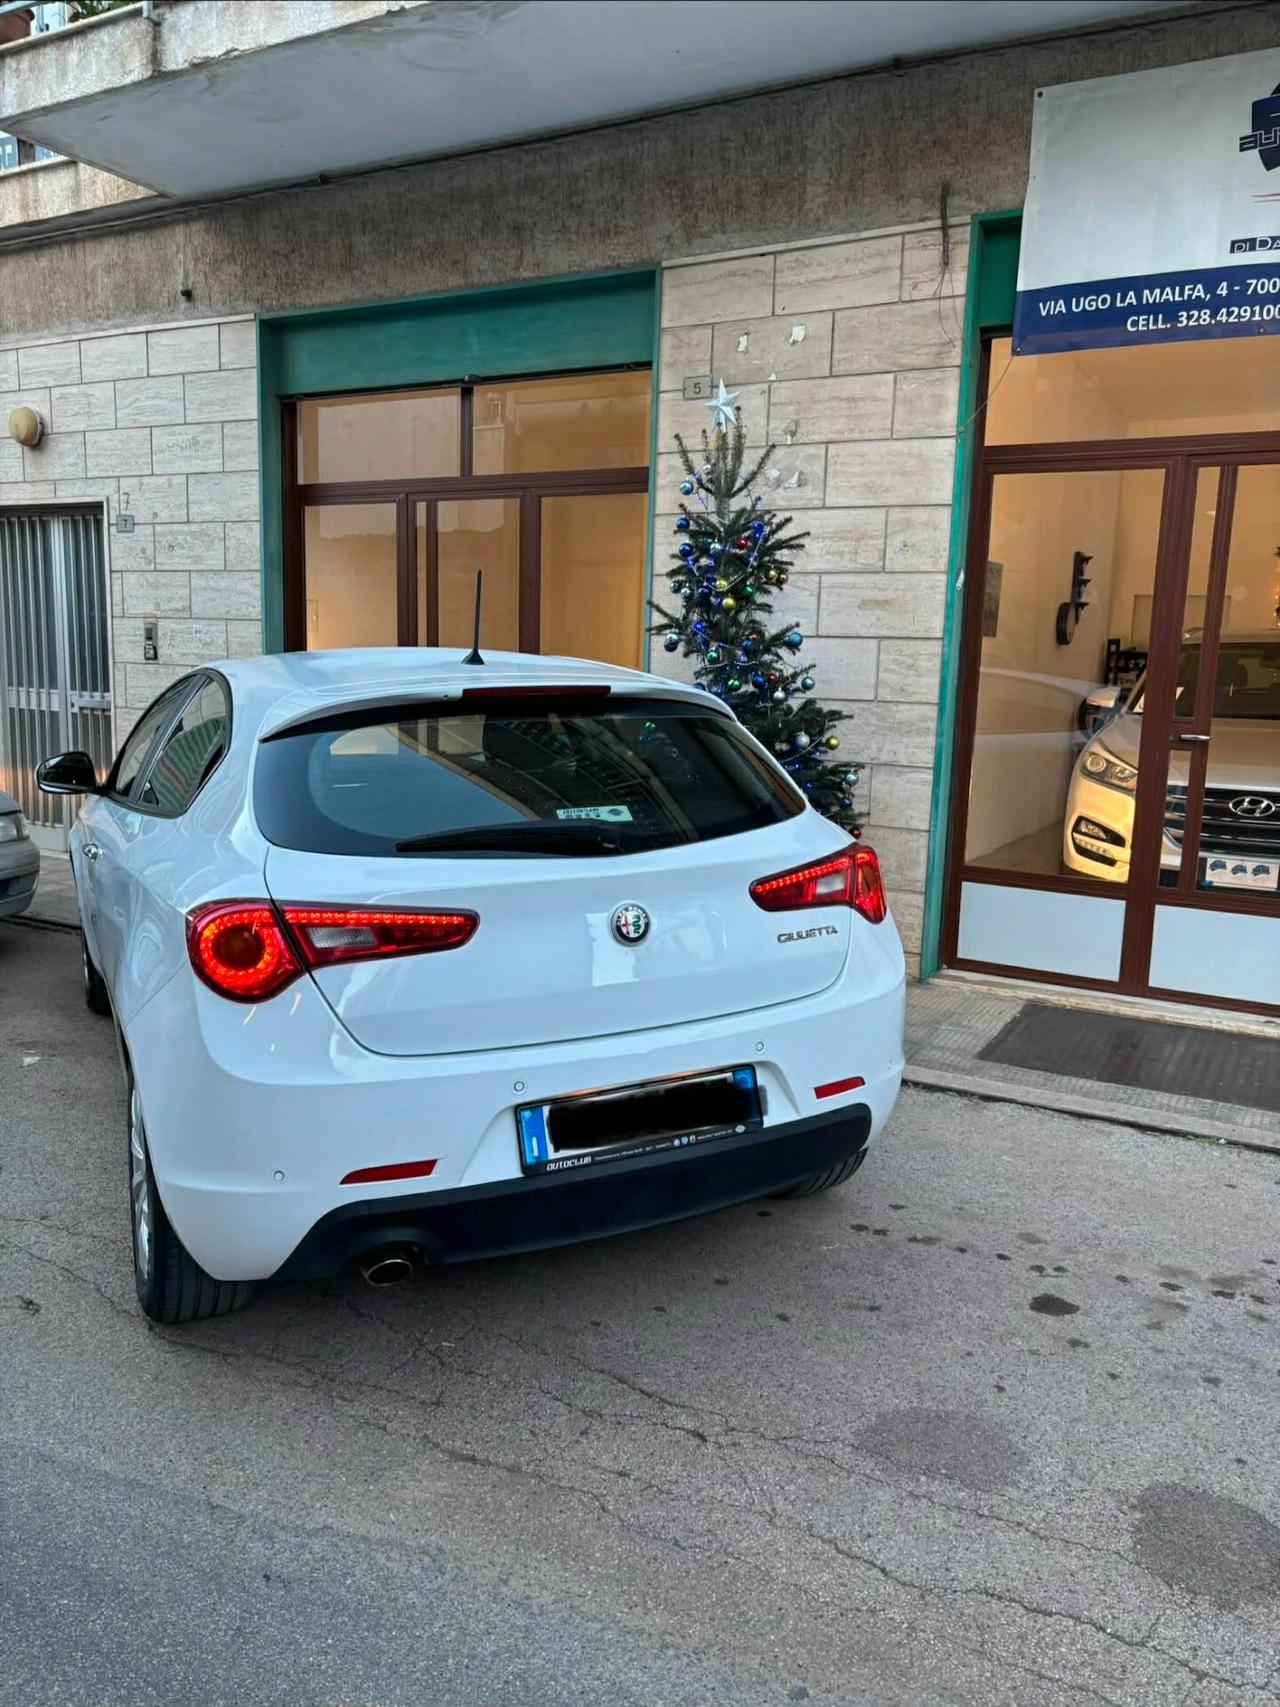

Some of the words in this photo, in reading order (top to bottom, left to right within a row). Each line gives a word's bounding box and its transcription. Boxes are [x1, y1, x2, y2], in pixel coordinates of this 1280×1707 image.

[1234, 241, 1250, 253] DI
[1039, 299, 1066, 317] VIA
[1071, 294, 1111, 313] UGO
[1116, 290, 1137, 308] LA
[1142, 282, 1211, 305] MALFA,
[1216, 281, 1228, 297] 4
[1126, 313, 1171, 332] CELL.
[693, 382, 702, 395] 5
[122, 492, 130, 512] 7
[122, 518, 128, 529] 7
[776, 924, 839, 944] GIULIETTA
